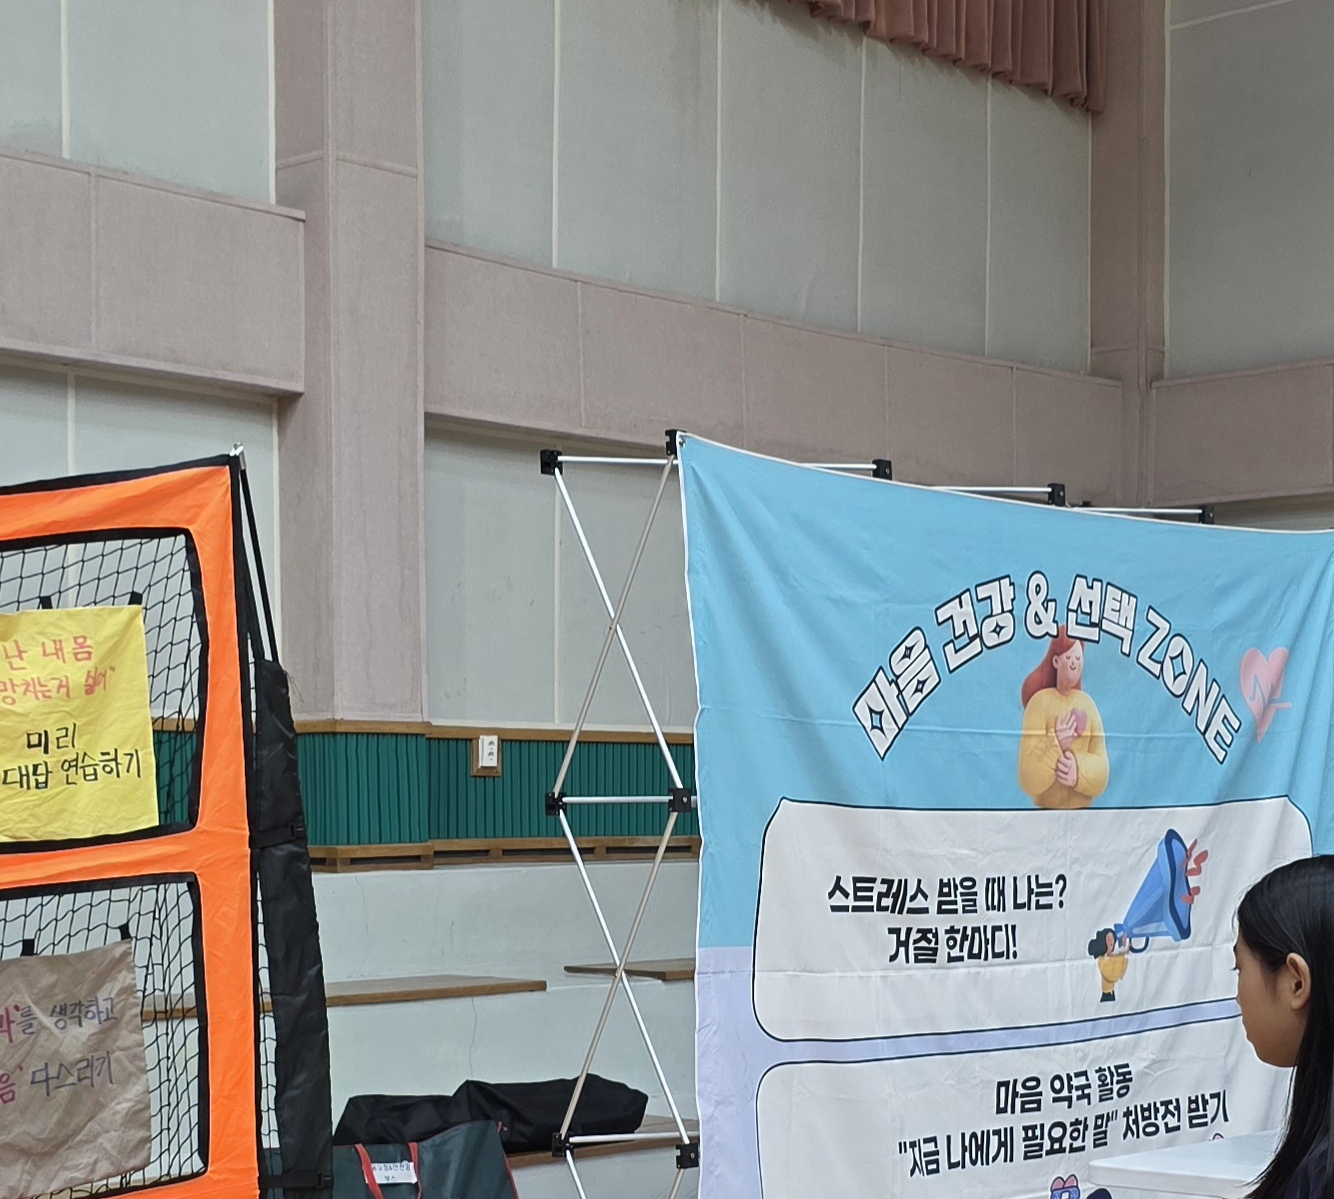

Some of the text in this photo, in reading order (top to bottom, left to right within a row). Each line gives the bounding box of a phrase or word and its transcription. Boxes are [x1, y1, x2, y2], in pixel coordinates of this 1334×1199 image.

[852, 570, 1242, 764] 마음 건강 & 선택 ZONE
[26, 722, 78, 755] 미리
[2, 748, 142, 791] 대답 연습하기
[827, 873, 1067, 915] 스트레스 받을 때 나는?
[887, 923, 1018, 964] 거절 한마디!
[49, 996, 119, 1030] 생각하고
[29, 1050, 115, 1097] 다스리기
[995, 1062, 1134, 1115] 마음 약국 활동
[898, 1089, 1229, 1178] "지금 나에게 필요한 말" 처방전 받기
